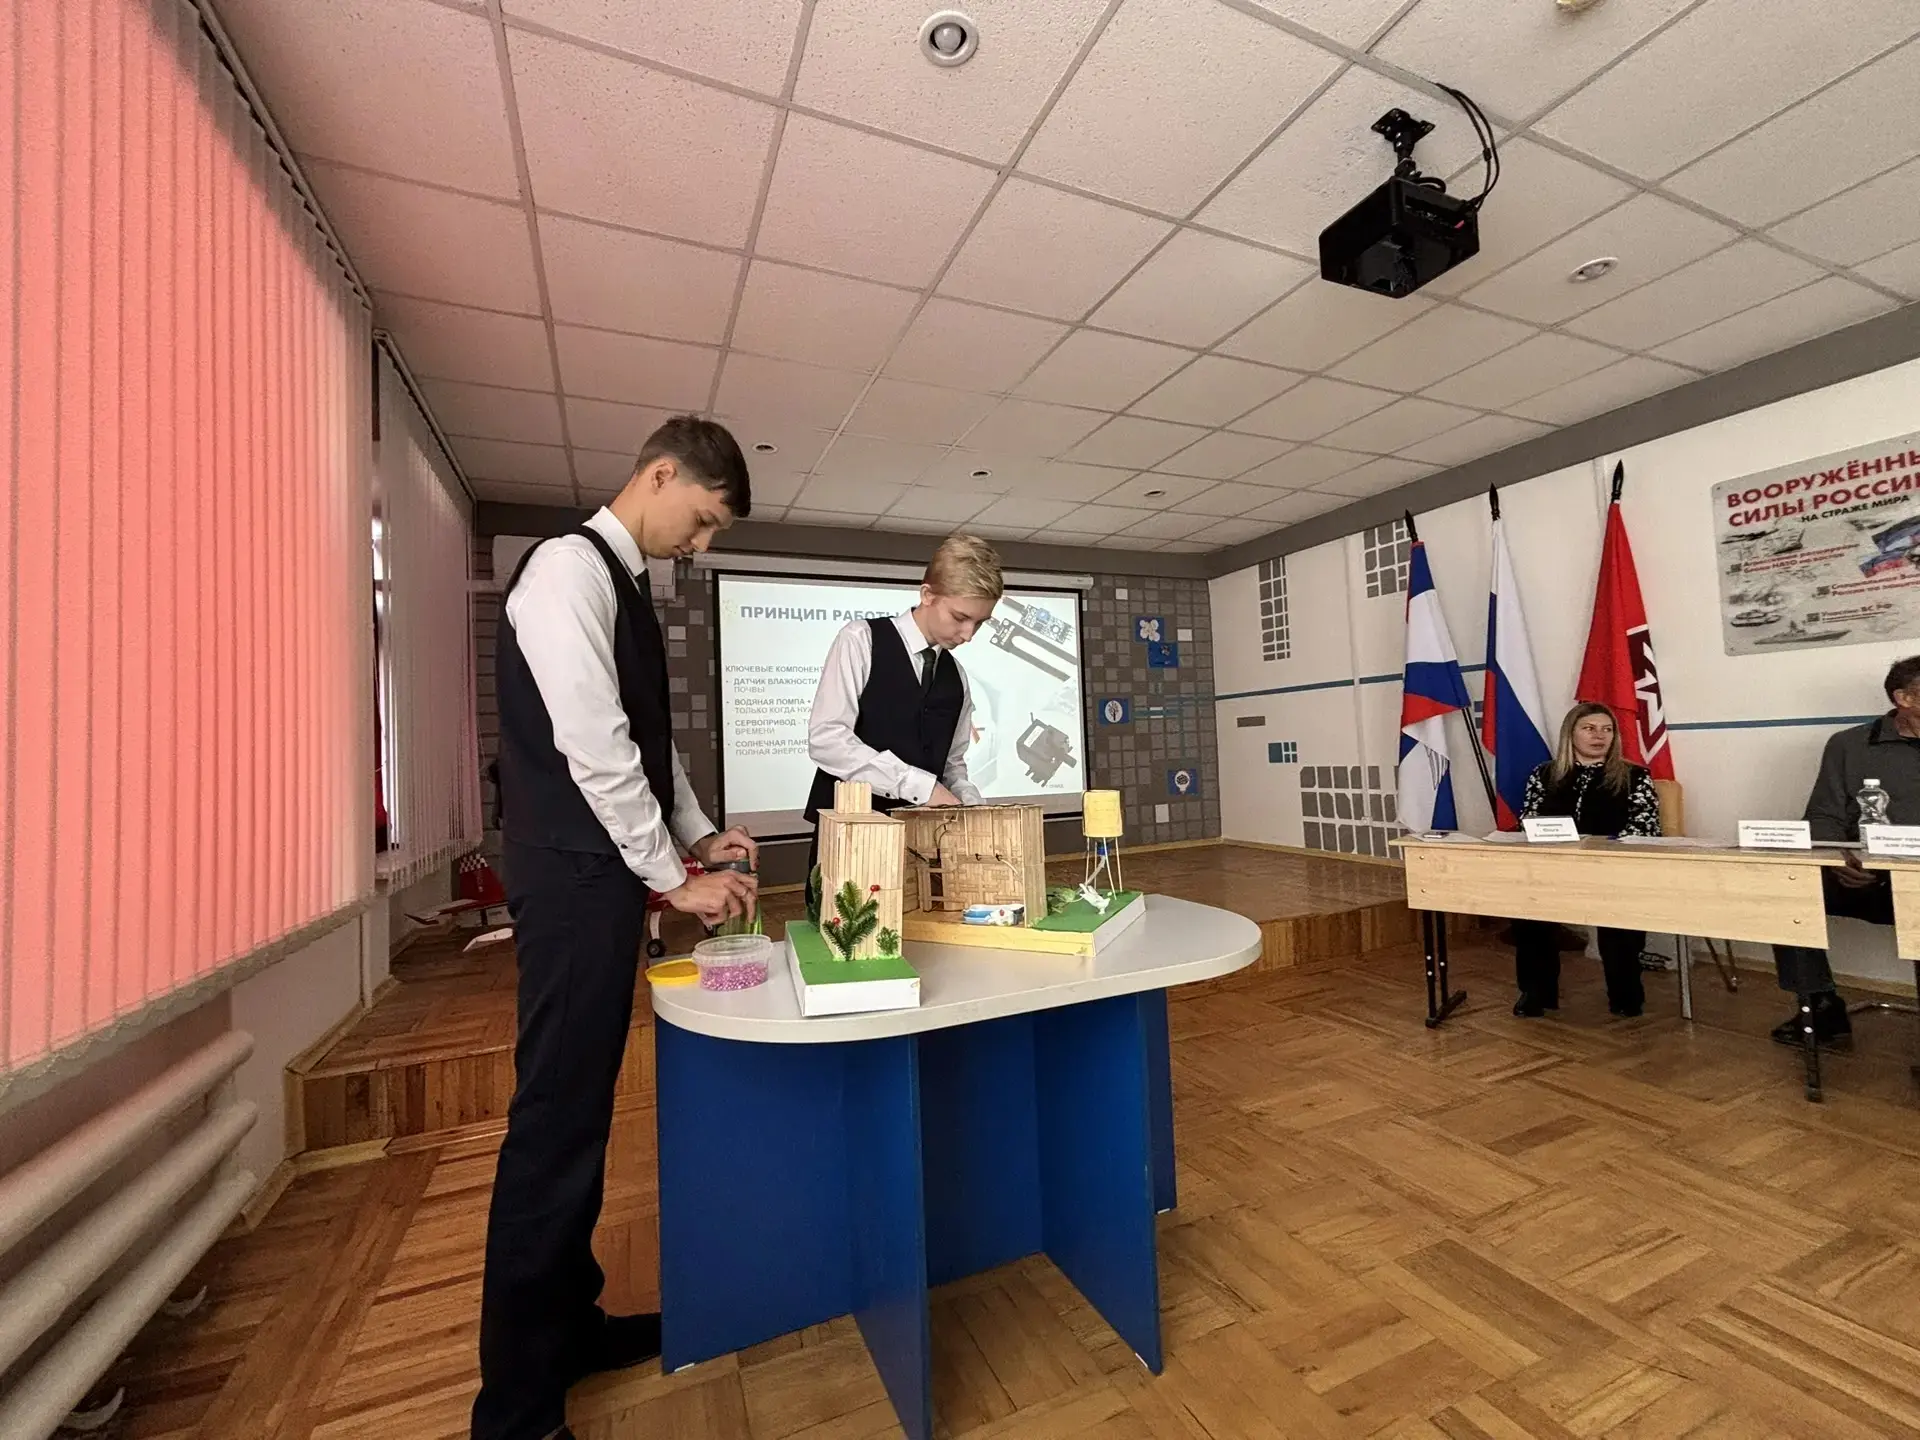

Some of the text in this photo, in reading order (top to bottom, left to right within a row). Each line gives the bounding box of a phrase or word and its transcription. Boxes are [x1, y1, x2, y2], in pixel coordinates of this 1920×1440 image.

[1728, 471, 1920, 526] СИЛЫ РОССИ
[1801, 495, 1910, 523] НА СТРАЖЕ МИРА
[740, 605, 826, 621] ПРИНЦИП
[725, 665, 774, 673] КЛЮЧЕВЫЕ
[733, 678, 766, 686] ДАТЧИК
[734, 698, 774, 706] ВОДЯНАЯ
